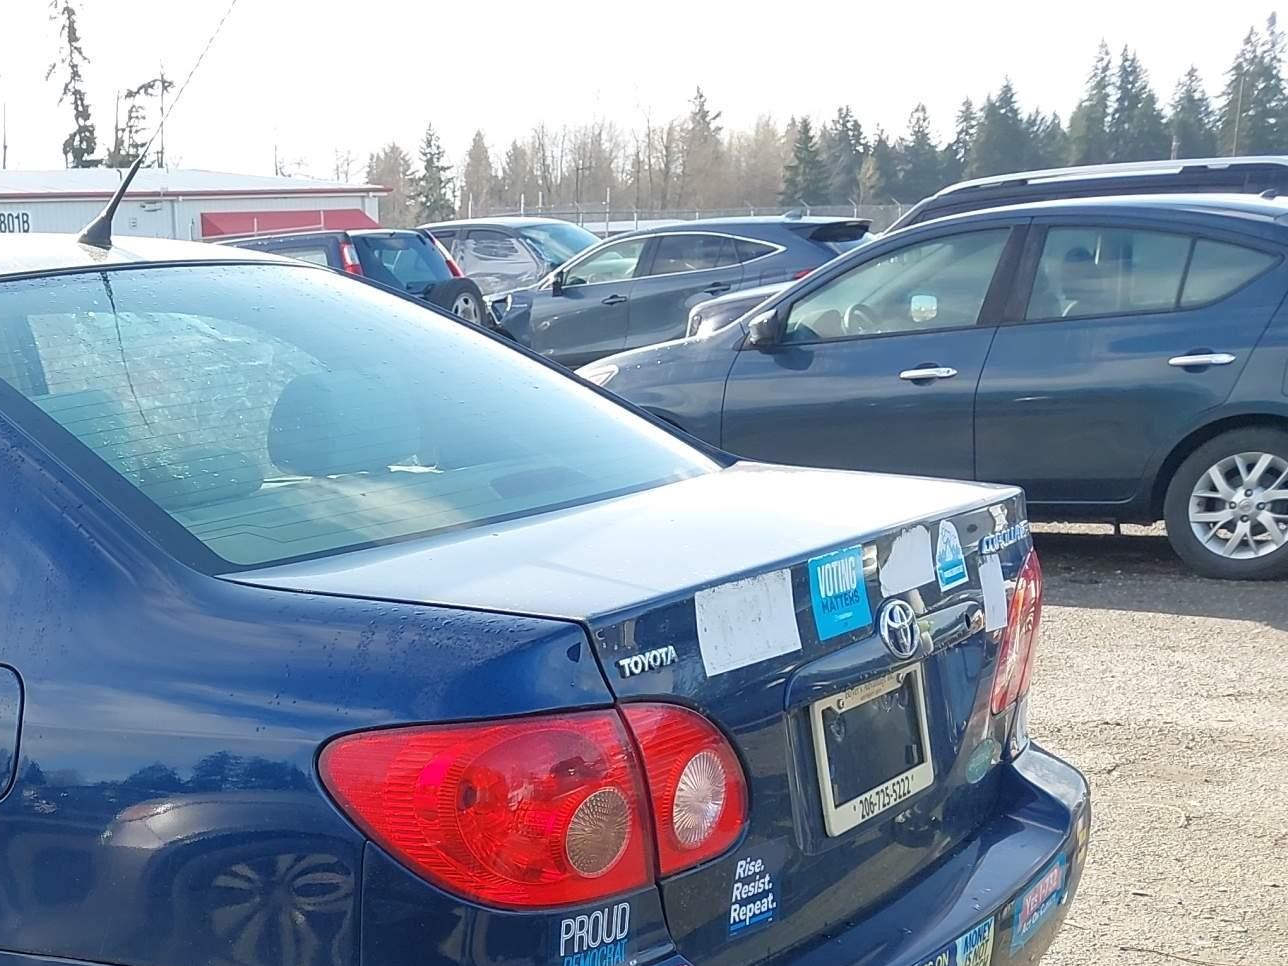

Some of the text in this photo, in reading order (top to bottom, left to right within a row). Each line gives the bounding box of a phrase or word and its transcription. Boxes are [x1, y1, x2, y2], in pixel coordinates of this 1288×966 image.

[817, 556, 857, 599] VOTING
[821, 589, 860, 615] MATTERS
[618, 645, 679, 677] TOYOTA
[735, 857, 765, 880] Rise.
[732, 873, 773, 903] Resist.
[730, 892, 777, 926] Repeat.
[559, 902, 630, 956] PROUD
[963, 919, 993, 955] MONEY
